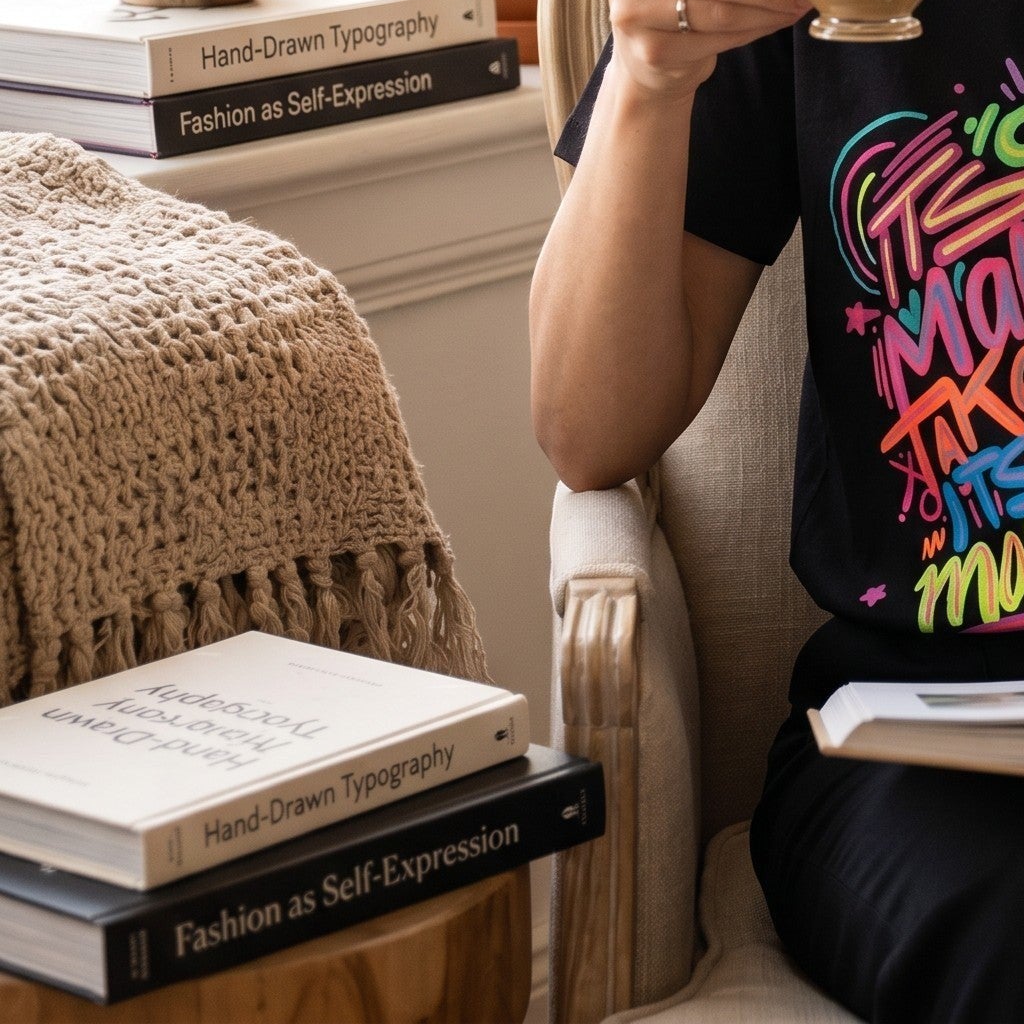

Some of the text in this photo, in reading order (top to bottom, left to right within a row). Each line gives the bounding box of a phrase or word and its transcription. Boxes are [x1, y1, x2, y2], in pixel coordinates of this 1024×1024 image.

[202, 33, 325, 70] Hand-Drawn
[329, 11, 439, 53] Typography
[179, 71, 433, 136] Fashion as Self-Expression
[42, 707, 259, 771] Hand-Drawn
[204, 787, 336, 847] Hand-Drawn
[341, 743, 455, 804] Typography
[174, 900, 282, 957] Fashion
[288, 887, 317, 918] as
[322, 823, 520, 907] Self-Expression
